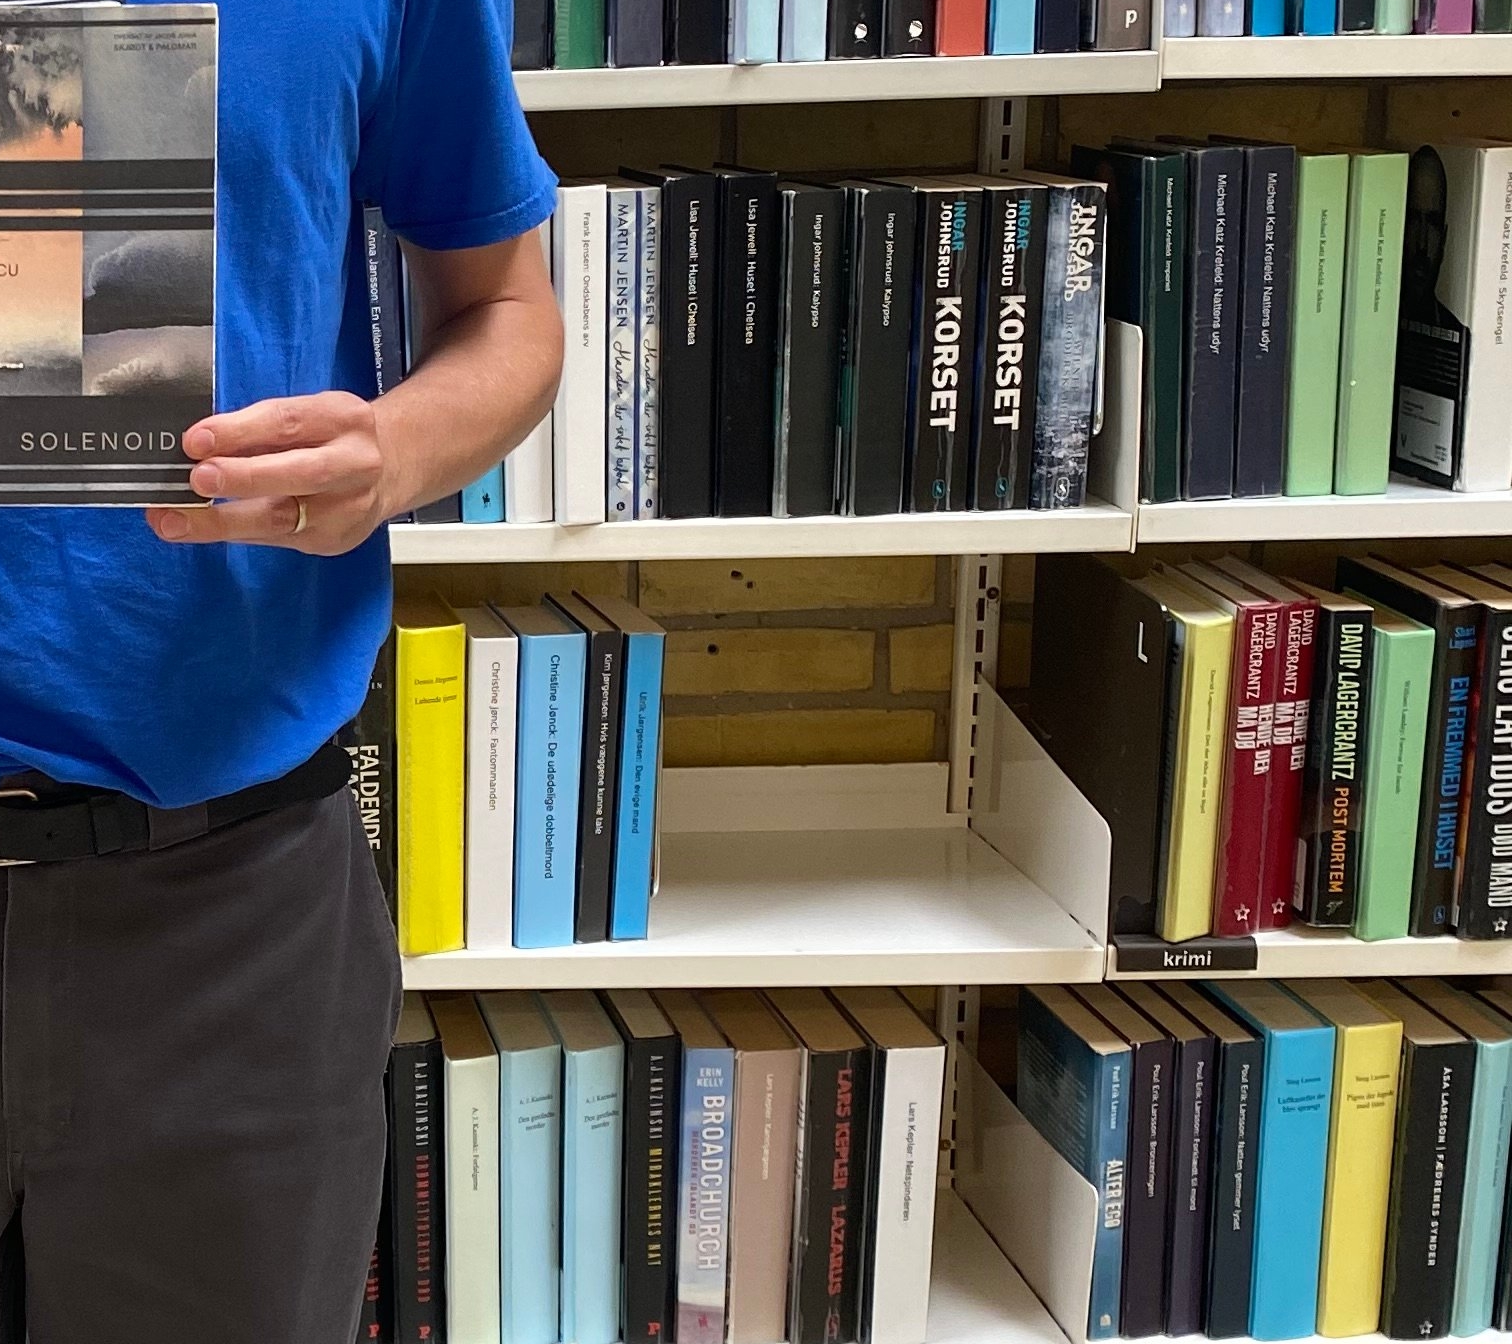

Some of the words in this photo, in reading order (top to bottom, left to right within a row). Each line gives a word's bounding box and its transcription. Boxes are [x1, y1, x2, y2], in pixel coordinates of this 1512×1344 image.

[1266, 173, 1277, 214] Michael
[616, 204, 629, 263] MARTIN
[1001, 200, 1016, 286] JOHNSRUD
[1017, 200, 1031, 249] INGAR
[1266, 217, 1275, 240] Katz
[616, 269, 629, 327] JENSEN
[1262, 286, 1273, 327] Nattens
[993, 295, 1025, 430] KORSET
[1260, 330, 1271, 352] udyr
[20, 432, 176, 452] SOLENOID
[1340, 624, 1363, 668] DAVID
[549, 655, 560, 701] Christine
[1449, 677, 1469, 701] EN
[548, 742, 557, 757] De
[1331, 672, 1359, 780] LAGERCRANTZ
[1440, 706, 1467, 796] FREMMED
[545, 760, 556, 811] udødelige
[1332, 787, 1350, 825] POST
[545, 815, 555, 879] dobbeltmord
[1329, 830, 1346, 892] MORTEM
[1434, 812, 1457, 870] HUSET
[1163, 951, 1212, 966] krimi
[836, 1069, 852, 1117] LARS
[1436, 1092, 1448, 1143] LARSSON
[832, 1122, 849, 1189] KEPLER
[1105, 1160, 1123, 1198] ALTER
[698, 1095, 726, 1269] BROADCHURCH
[1104, 1203, 1120, 1228] EGO
[828, 1205, 846, 1296] LAZARUS
[1428, 1220, 1439, 1266] SYNDER
